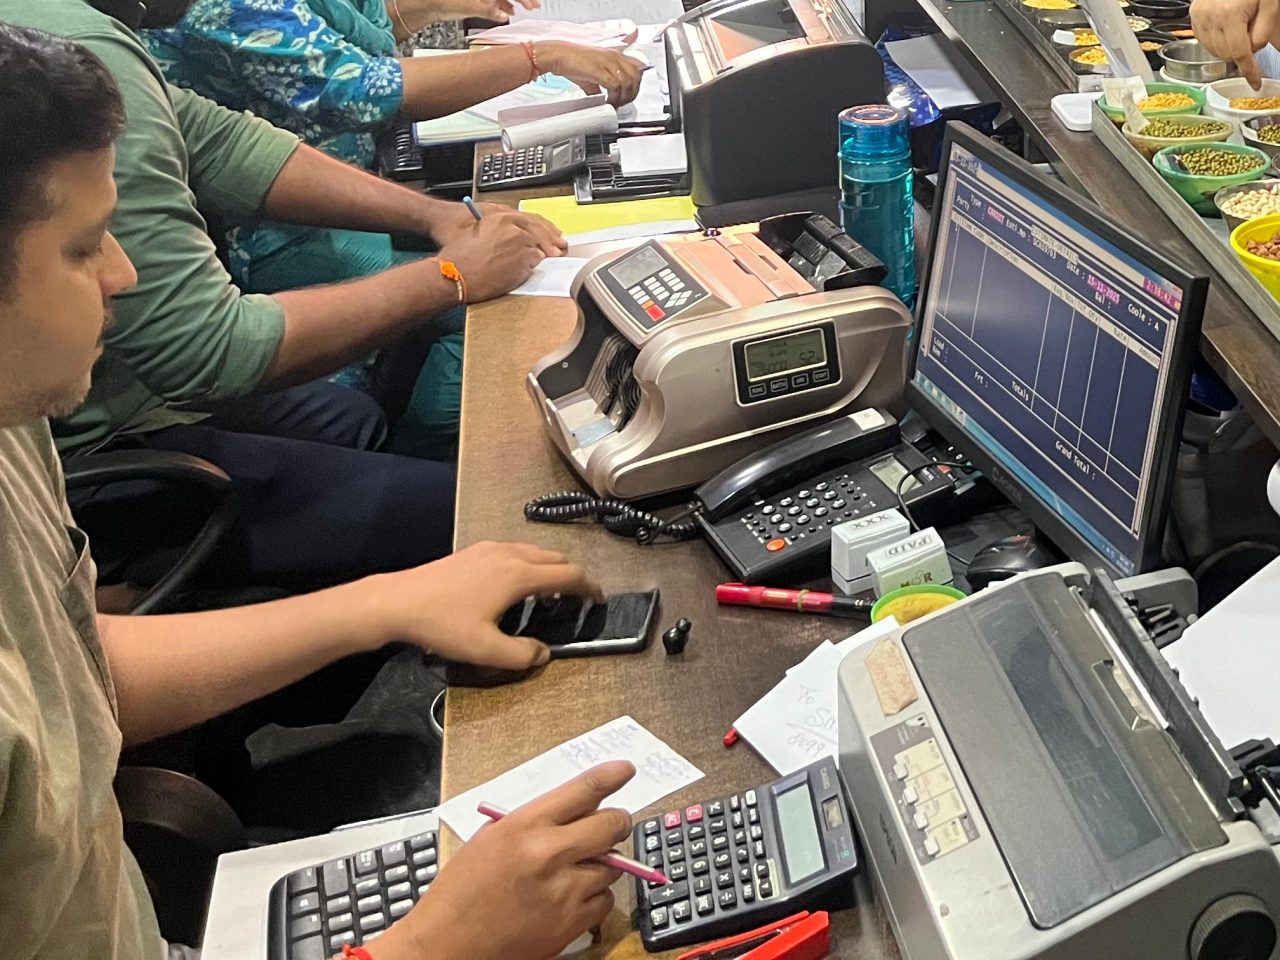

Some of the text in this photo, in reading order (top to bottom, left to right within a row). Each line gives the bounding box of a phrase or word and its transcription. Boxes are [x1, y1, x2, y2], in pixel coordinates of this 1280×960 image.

[1067, 262, 1079, 275] Date
[1154, 321, 1159, 331] A
[1011, 381, 1030, 401] Totals
[1055, 440, 1071, 460] Grand
[1073, 455, 1090, 474] Total
[888, 537, 927, 556] PAID
[712, 820, 724, 828] 7
[690, 826, 702, 834] 4
[692, 843, 704, 851] 5
[670, 849, 682, 858] 2
[716, 854, 728, 862] 9
[694, 861, 706, 869] 6
[672, 866, 684, 874] 3
